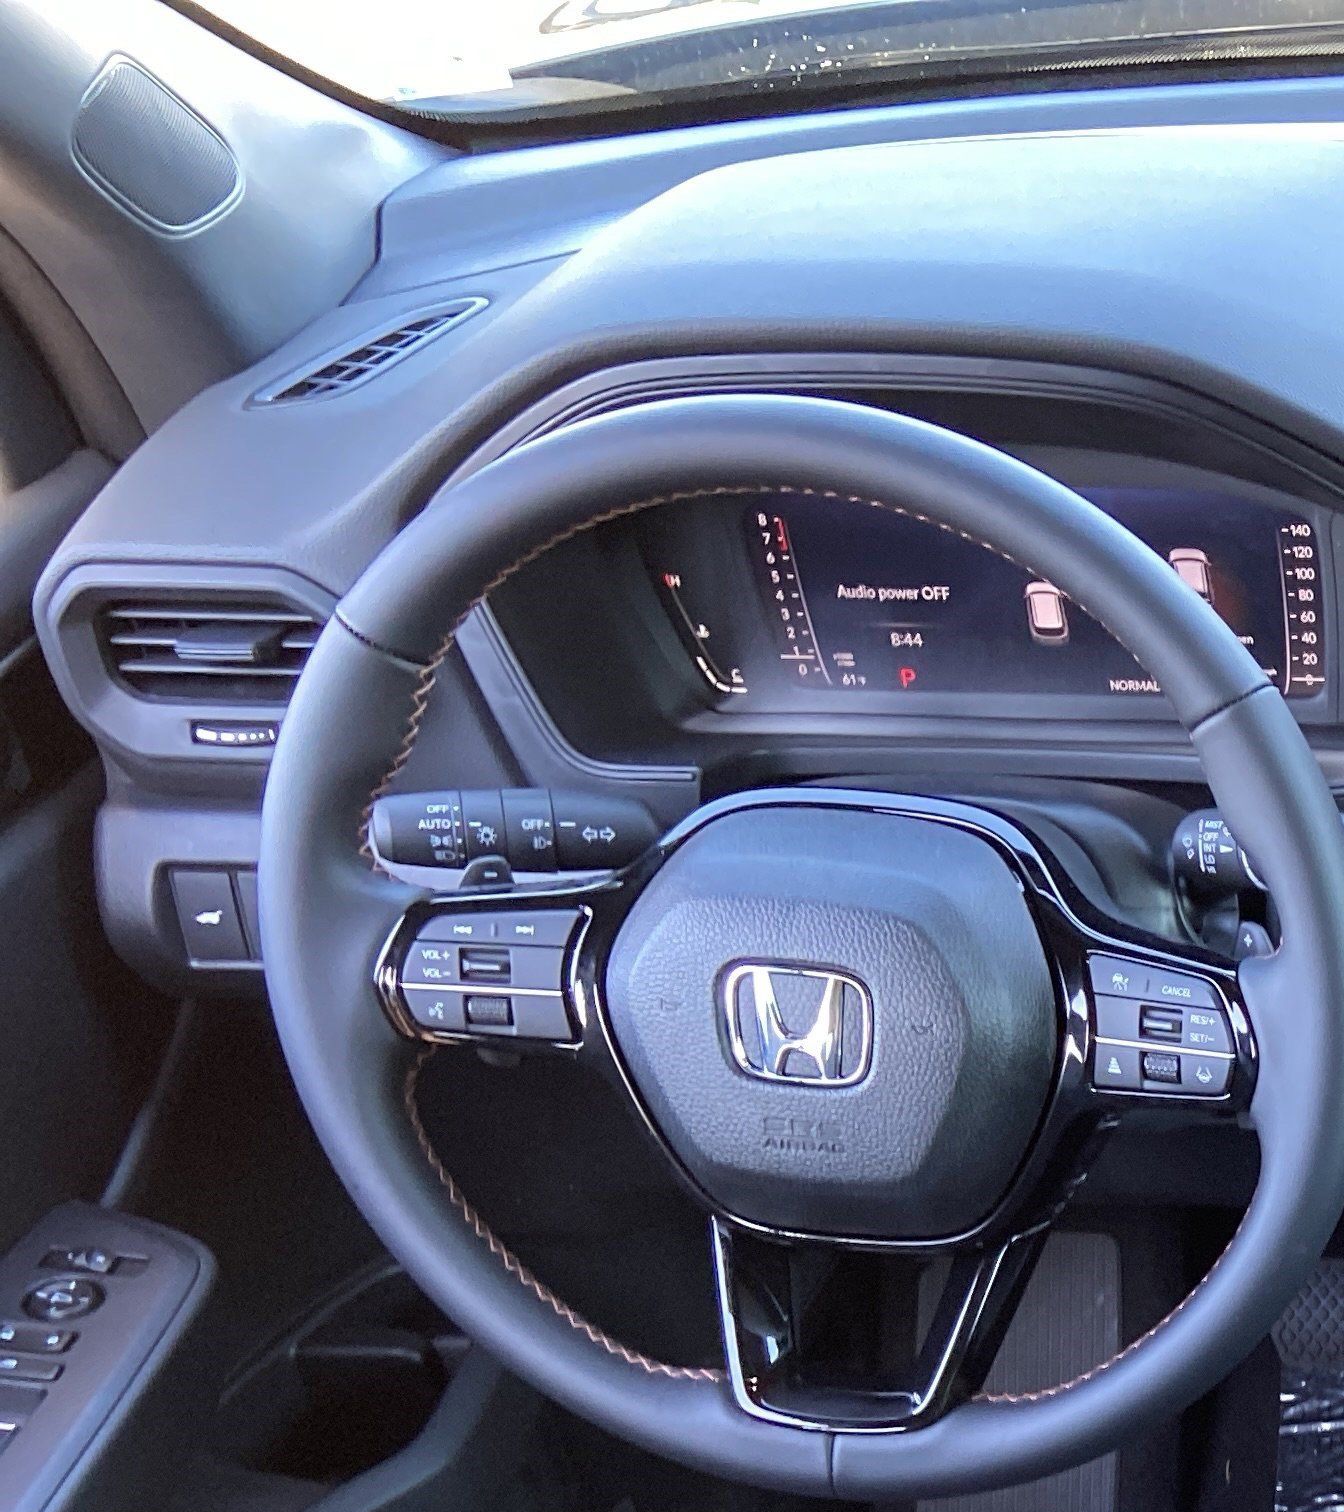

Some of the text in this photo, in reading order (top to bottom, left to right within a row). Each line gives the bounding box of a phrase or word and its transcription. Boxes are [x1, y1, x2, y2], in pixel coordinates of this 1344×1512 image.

[757, 512, 767, 527] 8
[1290, 525, 1311, 537] 140
[762, 532, 771, 545] 7
[766, 552, 775, 565] 6
[1293, 547, 1313, 559] 120
[771, 570, 780, 584] 5
[1295, 568, 1315, 580] 100
[775, 589, 785, 601] 4
[837, 585, 950, 602] Audio power OFF
[1299, 589, 1314, 602] 80
[780, 607, 790, 620] 3
[1300, 611, 1316, 623] 60
[786, 626, 795, 639] 2
[1301, 632, 1317, 644] 40
[890, 632, 924, 648] 8:44
[1303, 653, 1318, 665] 20
[900, 667, 916, 688] P
[1109, 679, 1160, 692] NORMAL
[427, 804, 449, 814] OFF
[418, 820, 450, 830] AUTO
[521, 819, 544, 830] OFF
[1203, 832, 1219, 842] OFF
[1161, 984, 1192, 998] CANCEL
